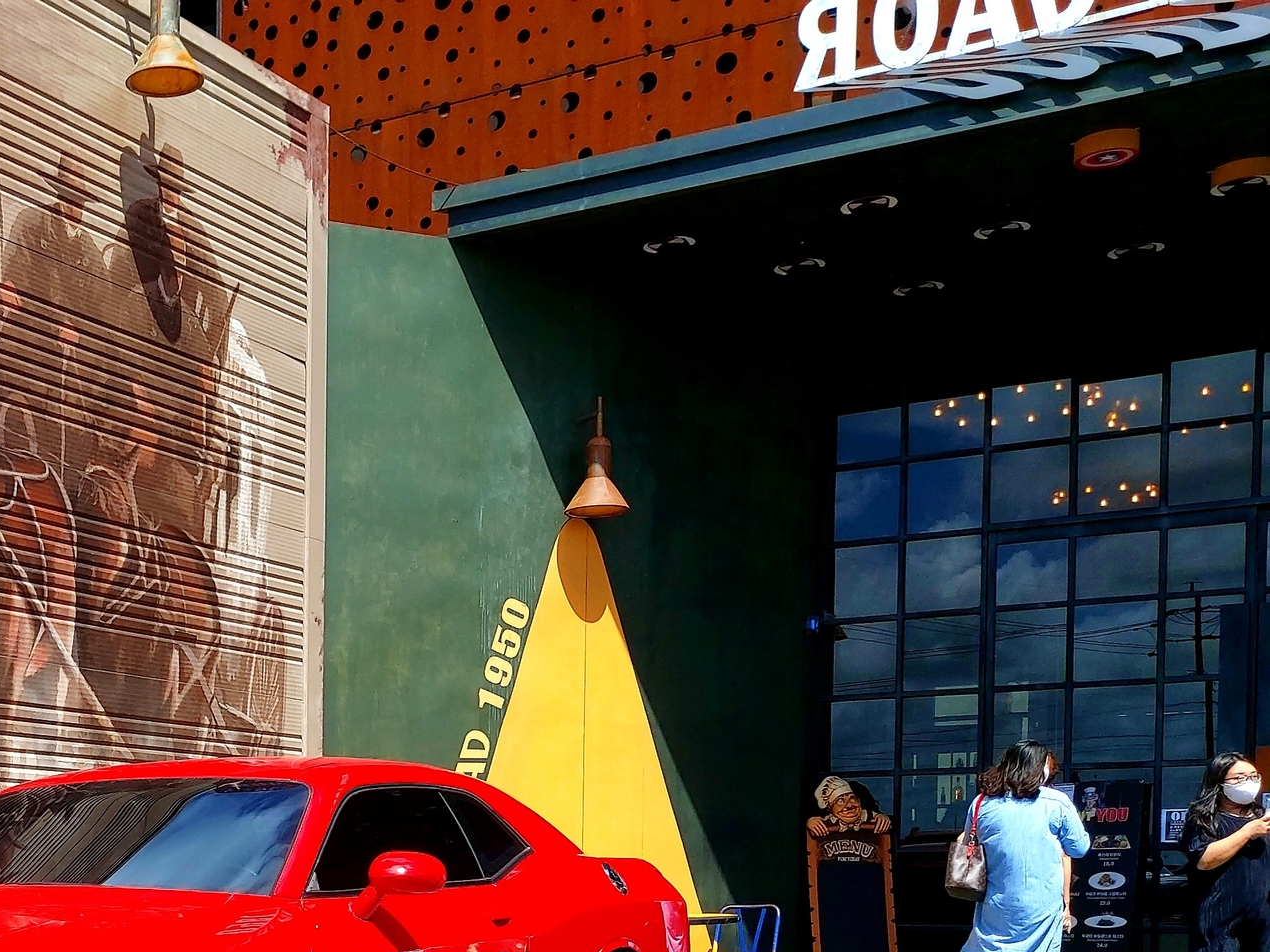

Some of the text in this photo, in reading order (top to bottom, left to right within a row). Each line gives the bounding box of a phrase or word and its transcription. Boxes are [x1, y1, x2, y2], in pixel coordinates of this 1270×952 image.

[478, 598, 530, 710] 1950
[1096, 807, 1129, 823] YOU
[824, 840, 873, 857] MENU
